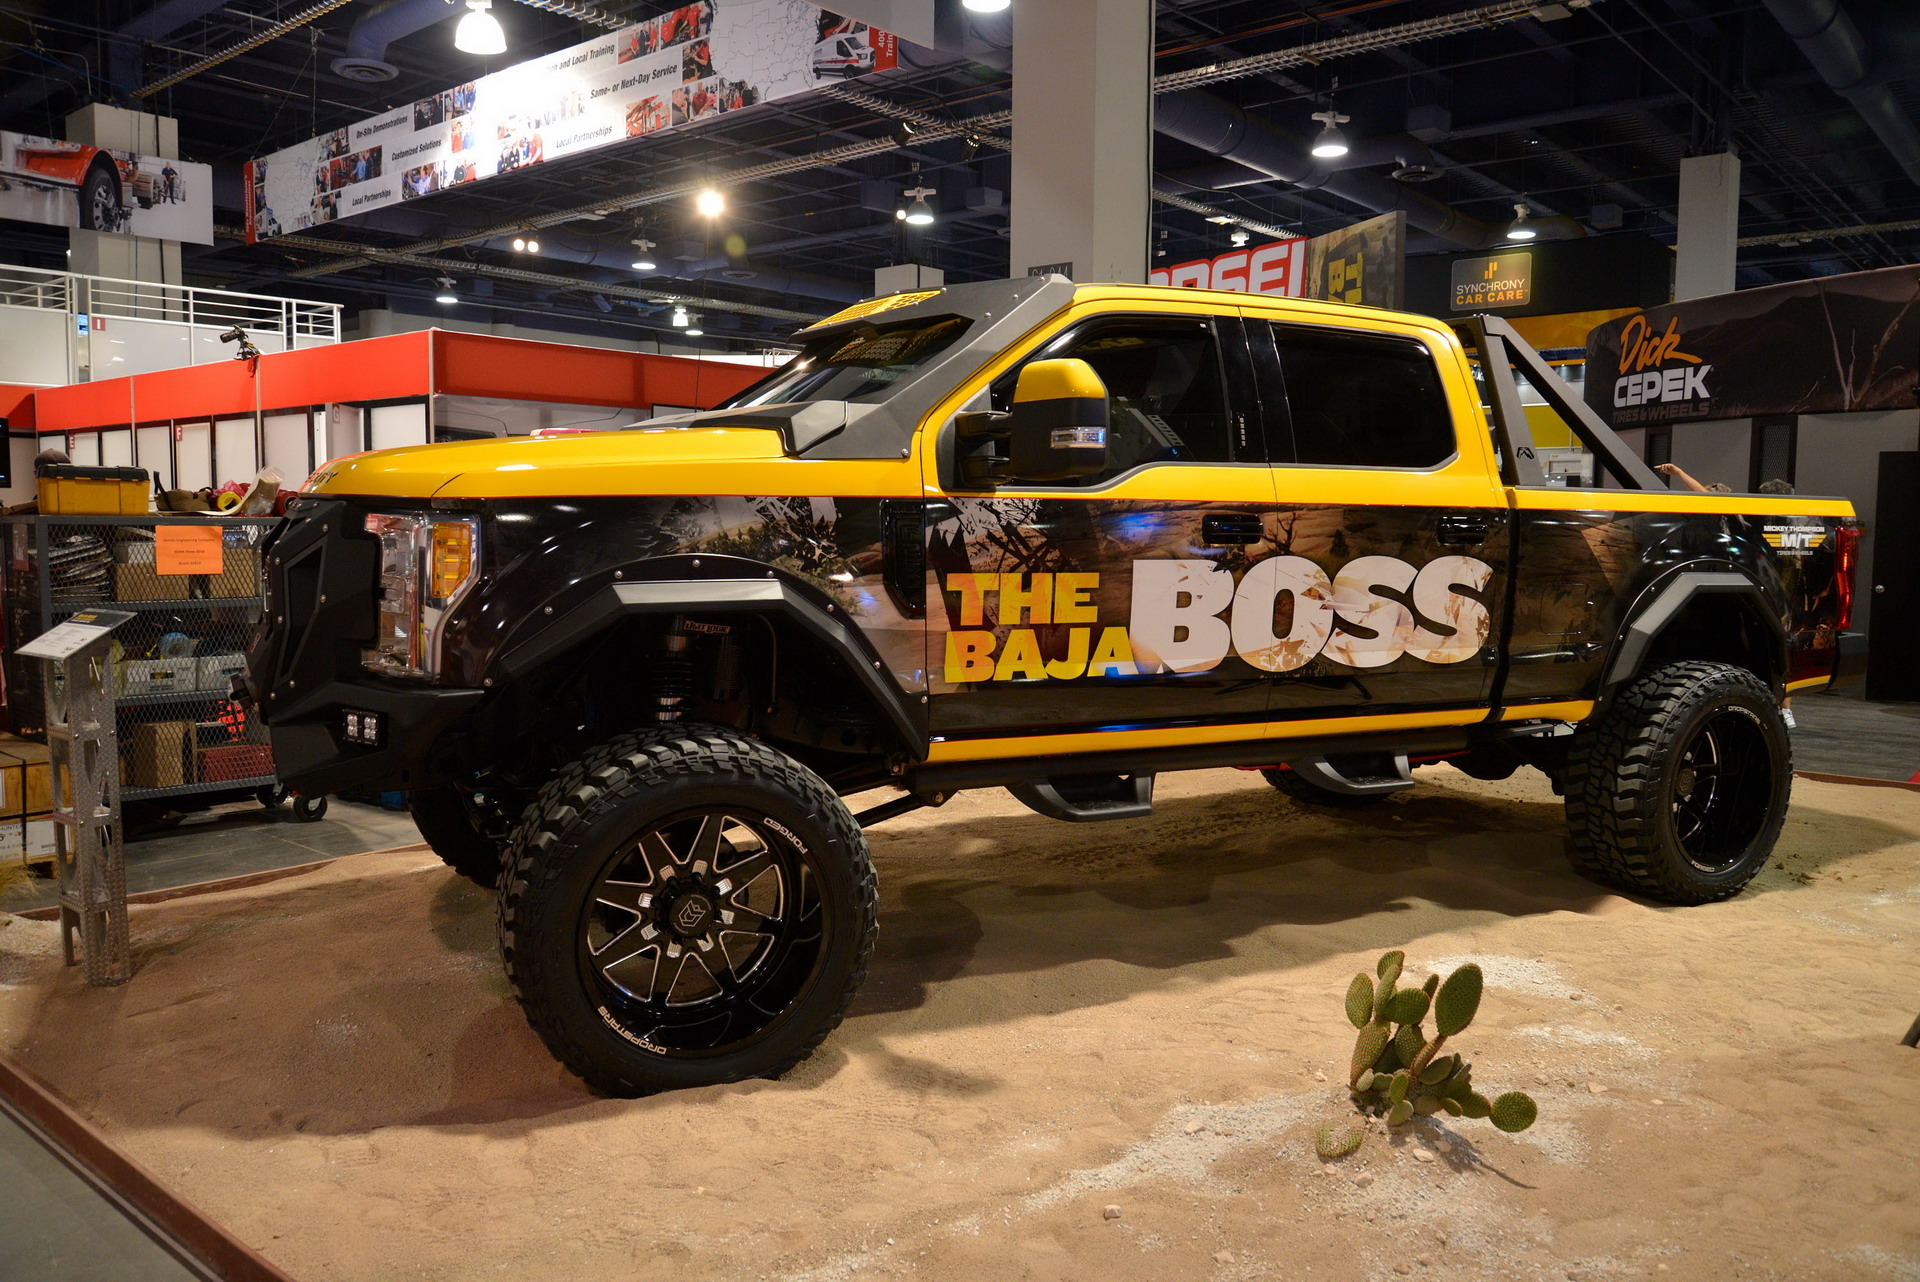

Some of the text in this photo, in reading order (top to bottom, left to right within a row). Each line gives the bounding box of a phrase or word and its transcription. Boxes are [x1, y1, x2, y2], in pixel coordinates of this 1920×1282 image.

[559, 58, 571, 70] and
[572, 52, 588, 66] Local
[590, 43, 615, 60] Training
[590, 64, 678, 99] Same- or Next-Day Service
[356, 115, 408, 139] On-Site Demonstrations
[556, 125, 613, 149] Local Partnerships
[391, 139, 442, 161] Customized Solutions
[352, 189, 391, 206] Local Partnerships
[1456, 278, 1525, 295] SYNCHRONY
[1456, 293, 1483, 305] CAR
[1618, 314, 1703, 375] Dick
[1613, 364, 1712, 408] CEPEK
[69, 436, 75, 448] E
[176, 427, 182, 440] F
[1781, 533, 1813, 548] M/T
[946, 572, 1100, 626] THE
[1131, 555, 1494, 674] BOSS
[944, 627, 1141, 683] BAJA
[764, 817, 808, 854] FORGED
[597, 1005, 667, 1055] DROPSTARS
